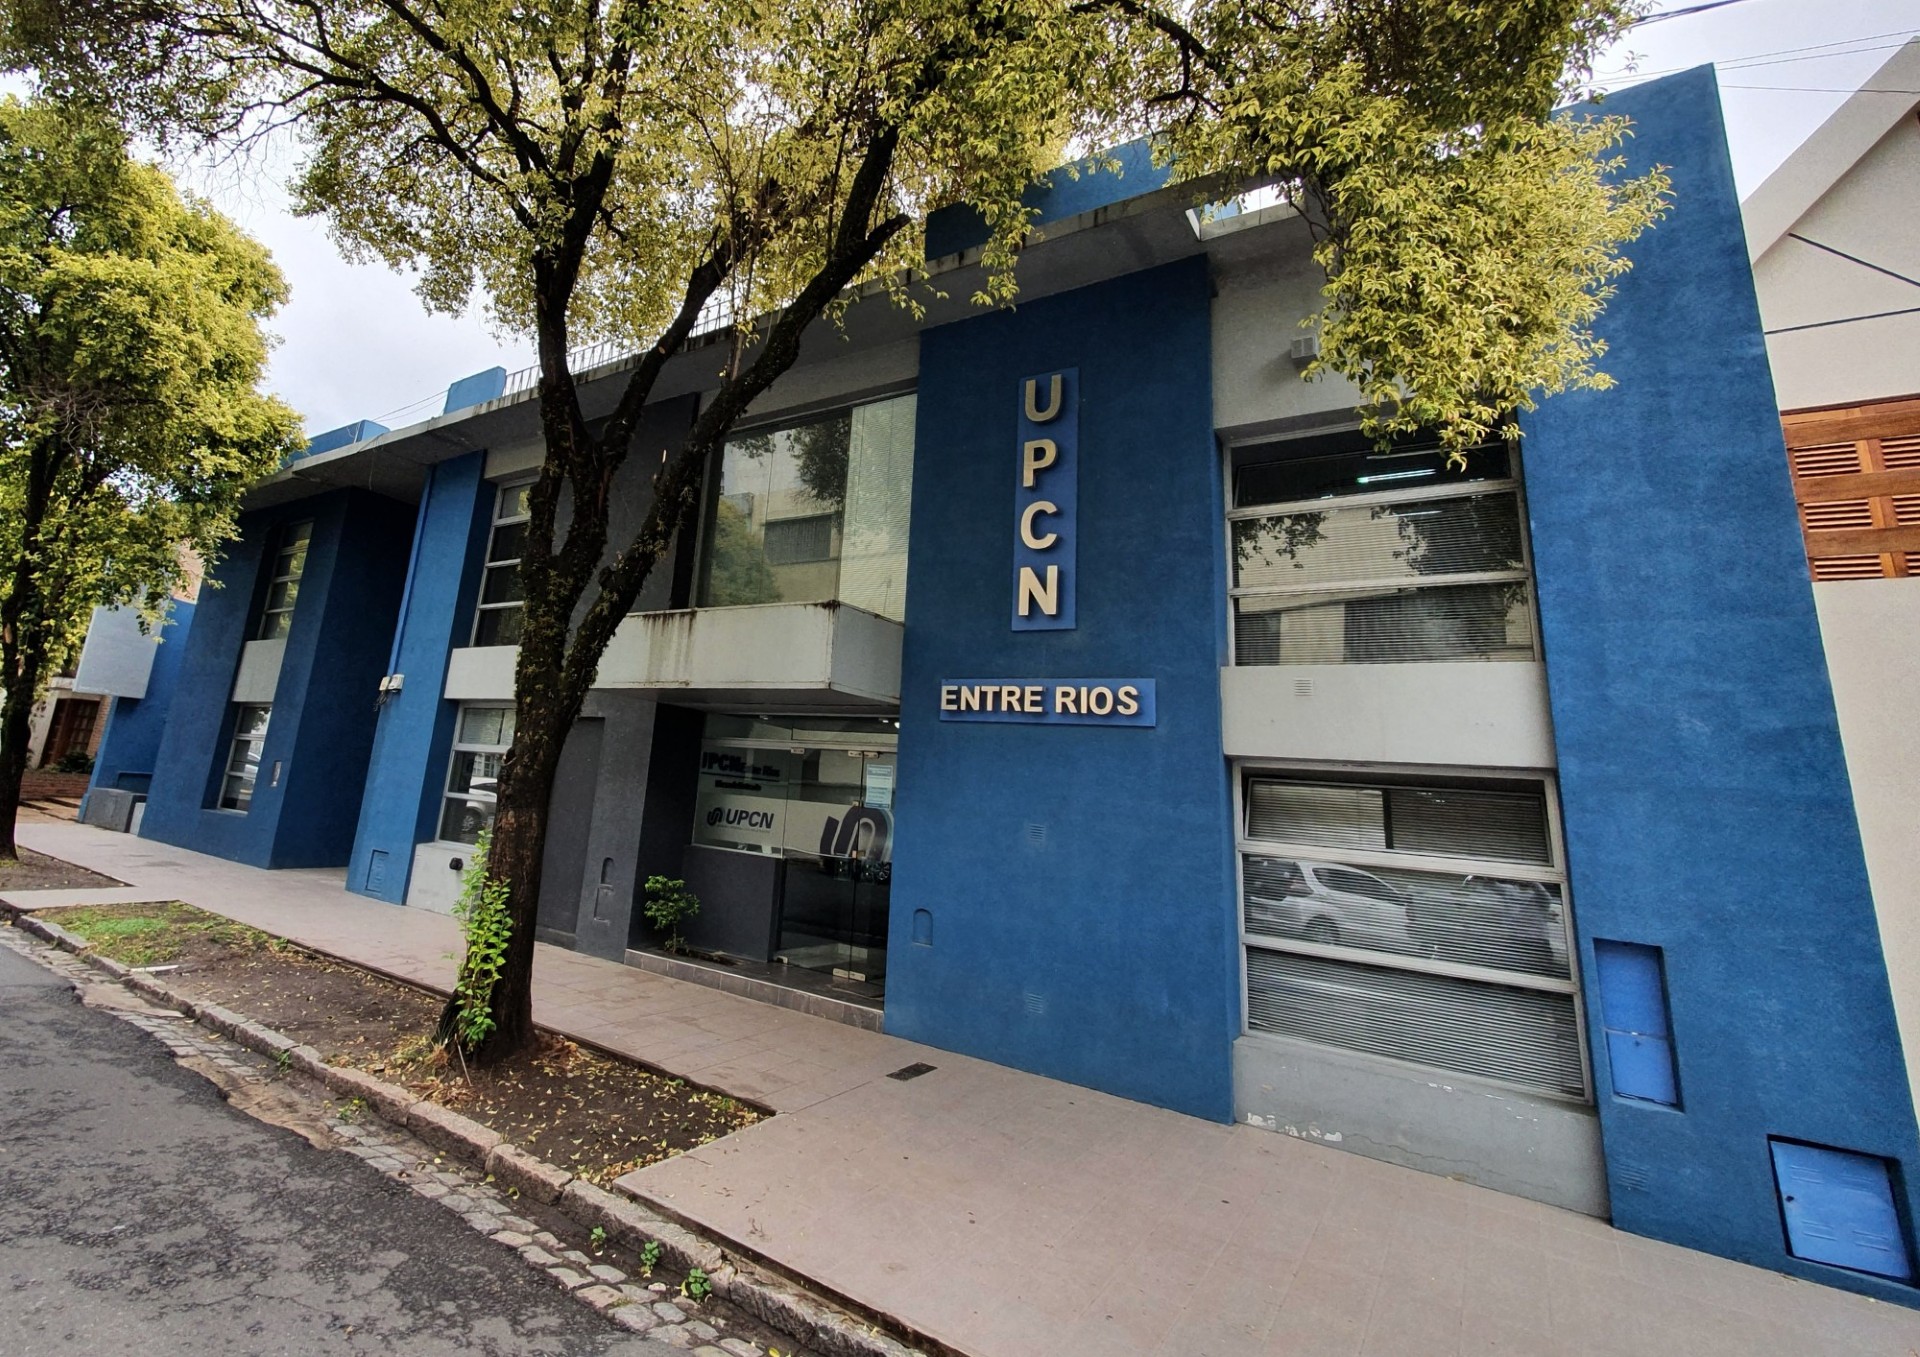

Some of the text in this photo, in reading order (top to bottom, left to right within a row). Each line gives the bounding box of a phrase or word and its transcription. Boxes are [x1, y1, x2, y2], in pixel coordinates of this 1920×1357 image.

[1018, 374, 1062, 616] UPCN
[941, 685, 1139, 715] ENTRE RIOS
[726, 809, 774, 829] UPCN
